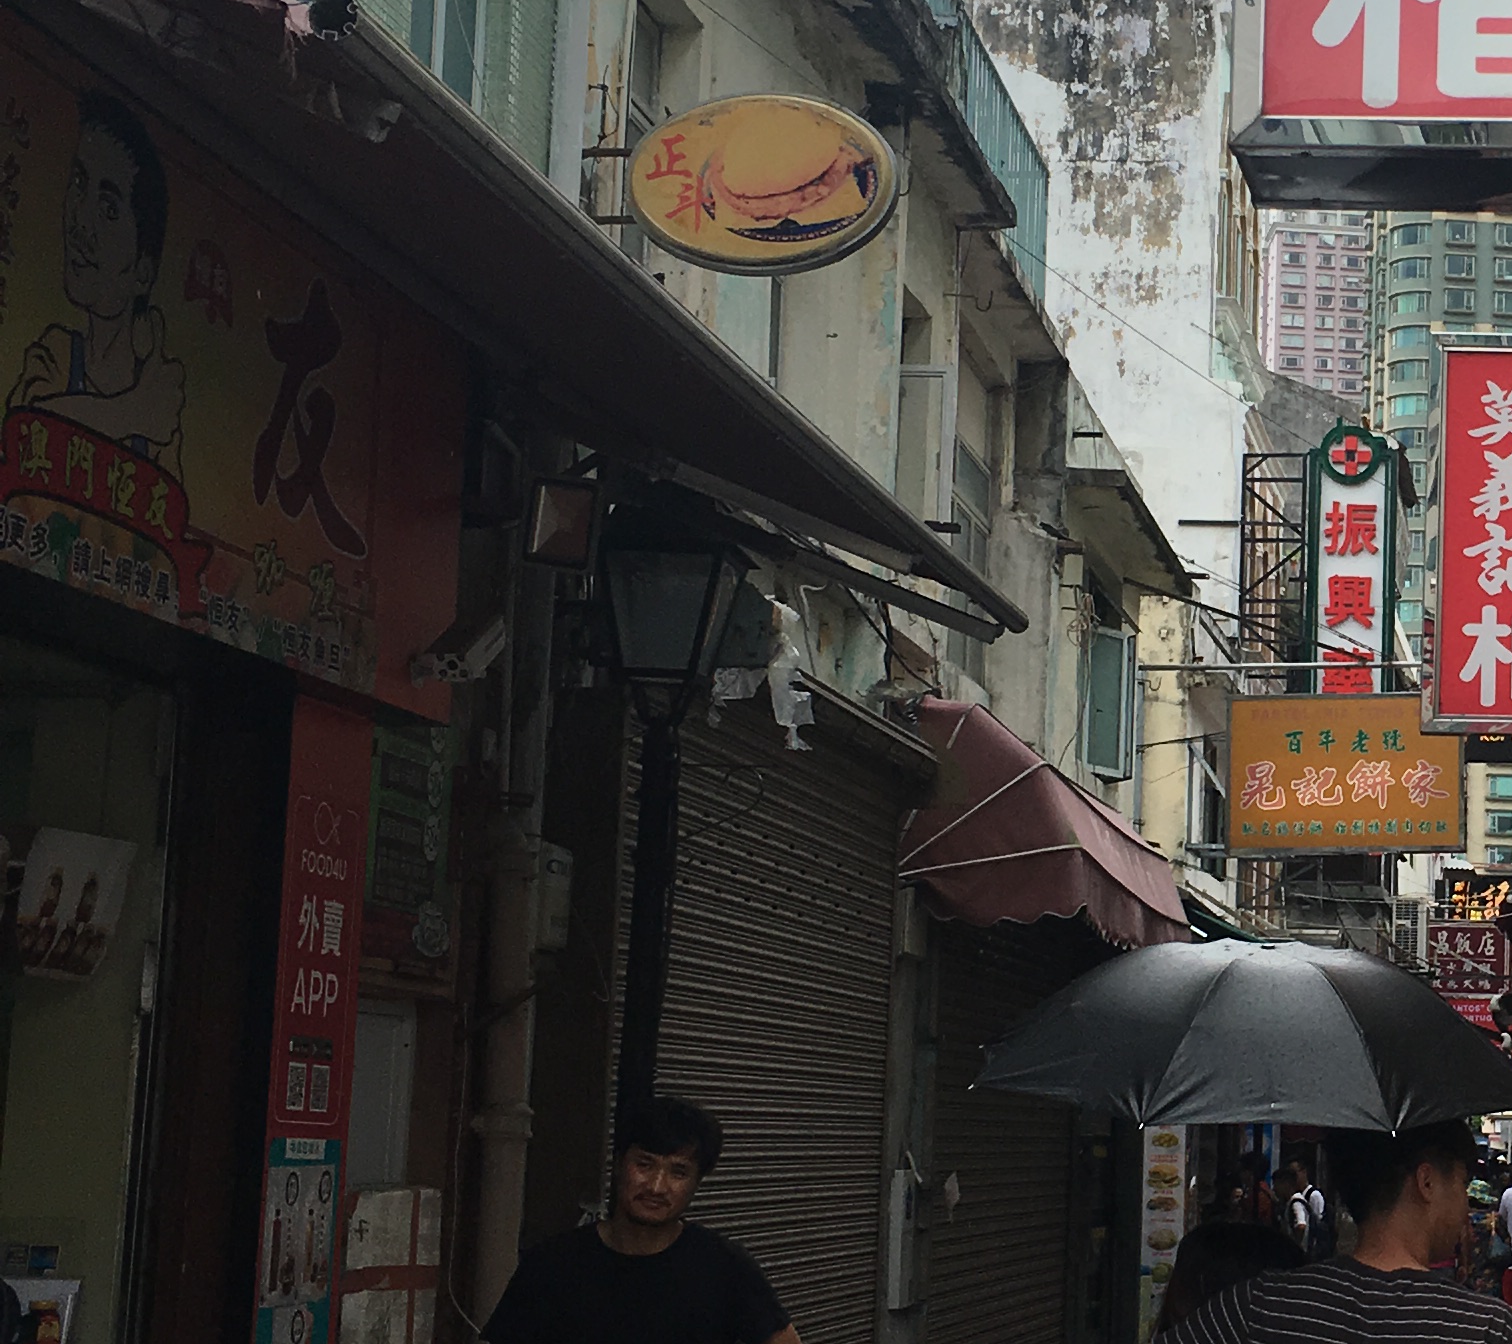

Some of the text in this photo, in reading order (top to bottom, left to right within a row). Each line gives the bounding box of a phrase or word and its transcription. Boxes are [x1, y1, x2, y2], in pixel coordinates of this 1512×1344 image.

[1285, 729, 1405, 754] 百年老號
[1240, 759, 1450, 810] 晃記餅家
[301, 848, 347, 881] FOOD4U
[298, 895, 344, 956] 外賣
[291, 968, 338, 1017] APP
